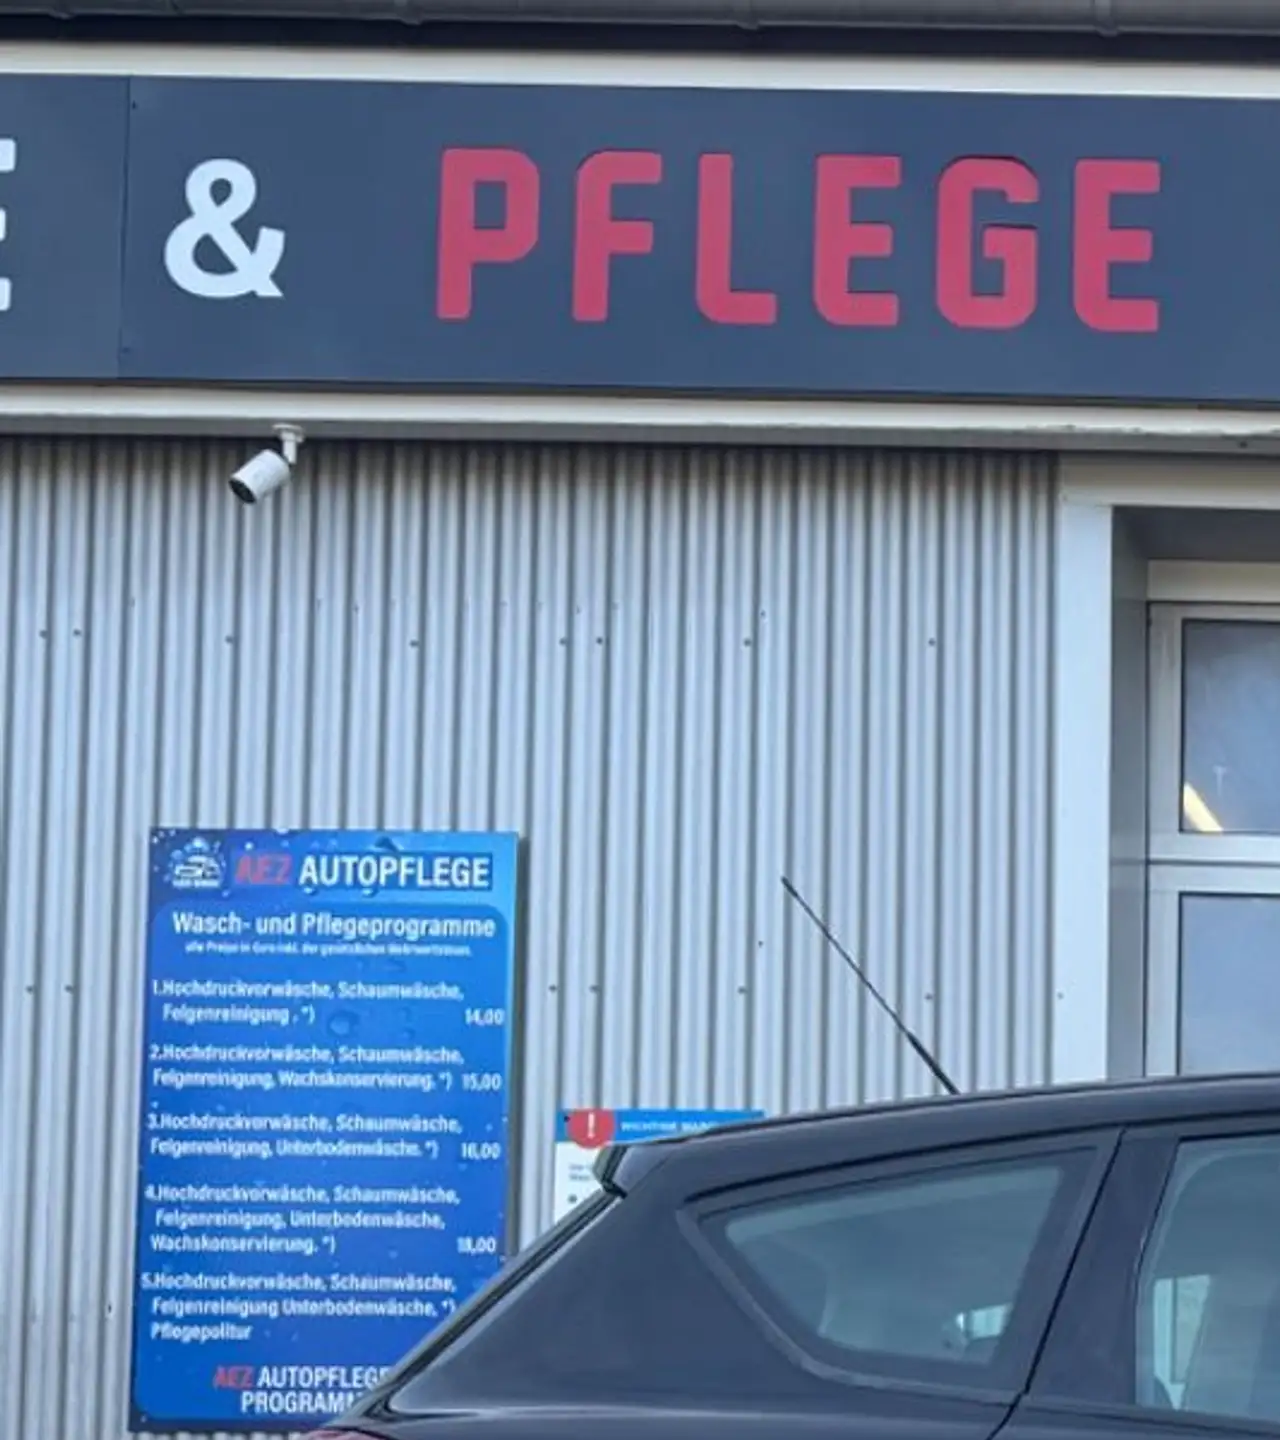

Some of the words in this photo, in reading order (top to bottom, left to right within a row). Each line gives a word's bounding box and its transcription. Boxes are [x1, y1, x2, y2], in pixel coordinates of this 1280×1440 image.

[165, 159, 285, 298] &
[437, 147, 1160, 332] PFLEGE
[234, 853, 293, 884] AEZ
[299, 855, 489, 888] AUTOPFLEGE
[173, 911, 250, 935] Wasch-
[256, 913, 296, 935] und
[302, 911, 496, 941] Pflegeprogramme
[214, 1365, 253, 1389] AEZ
